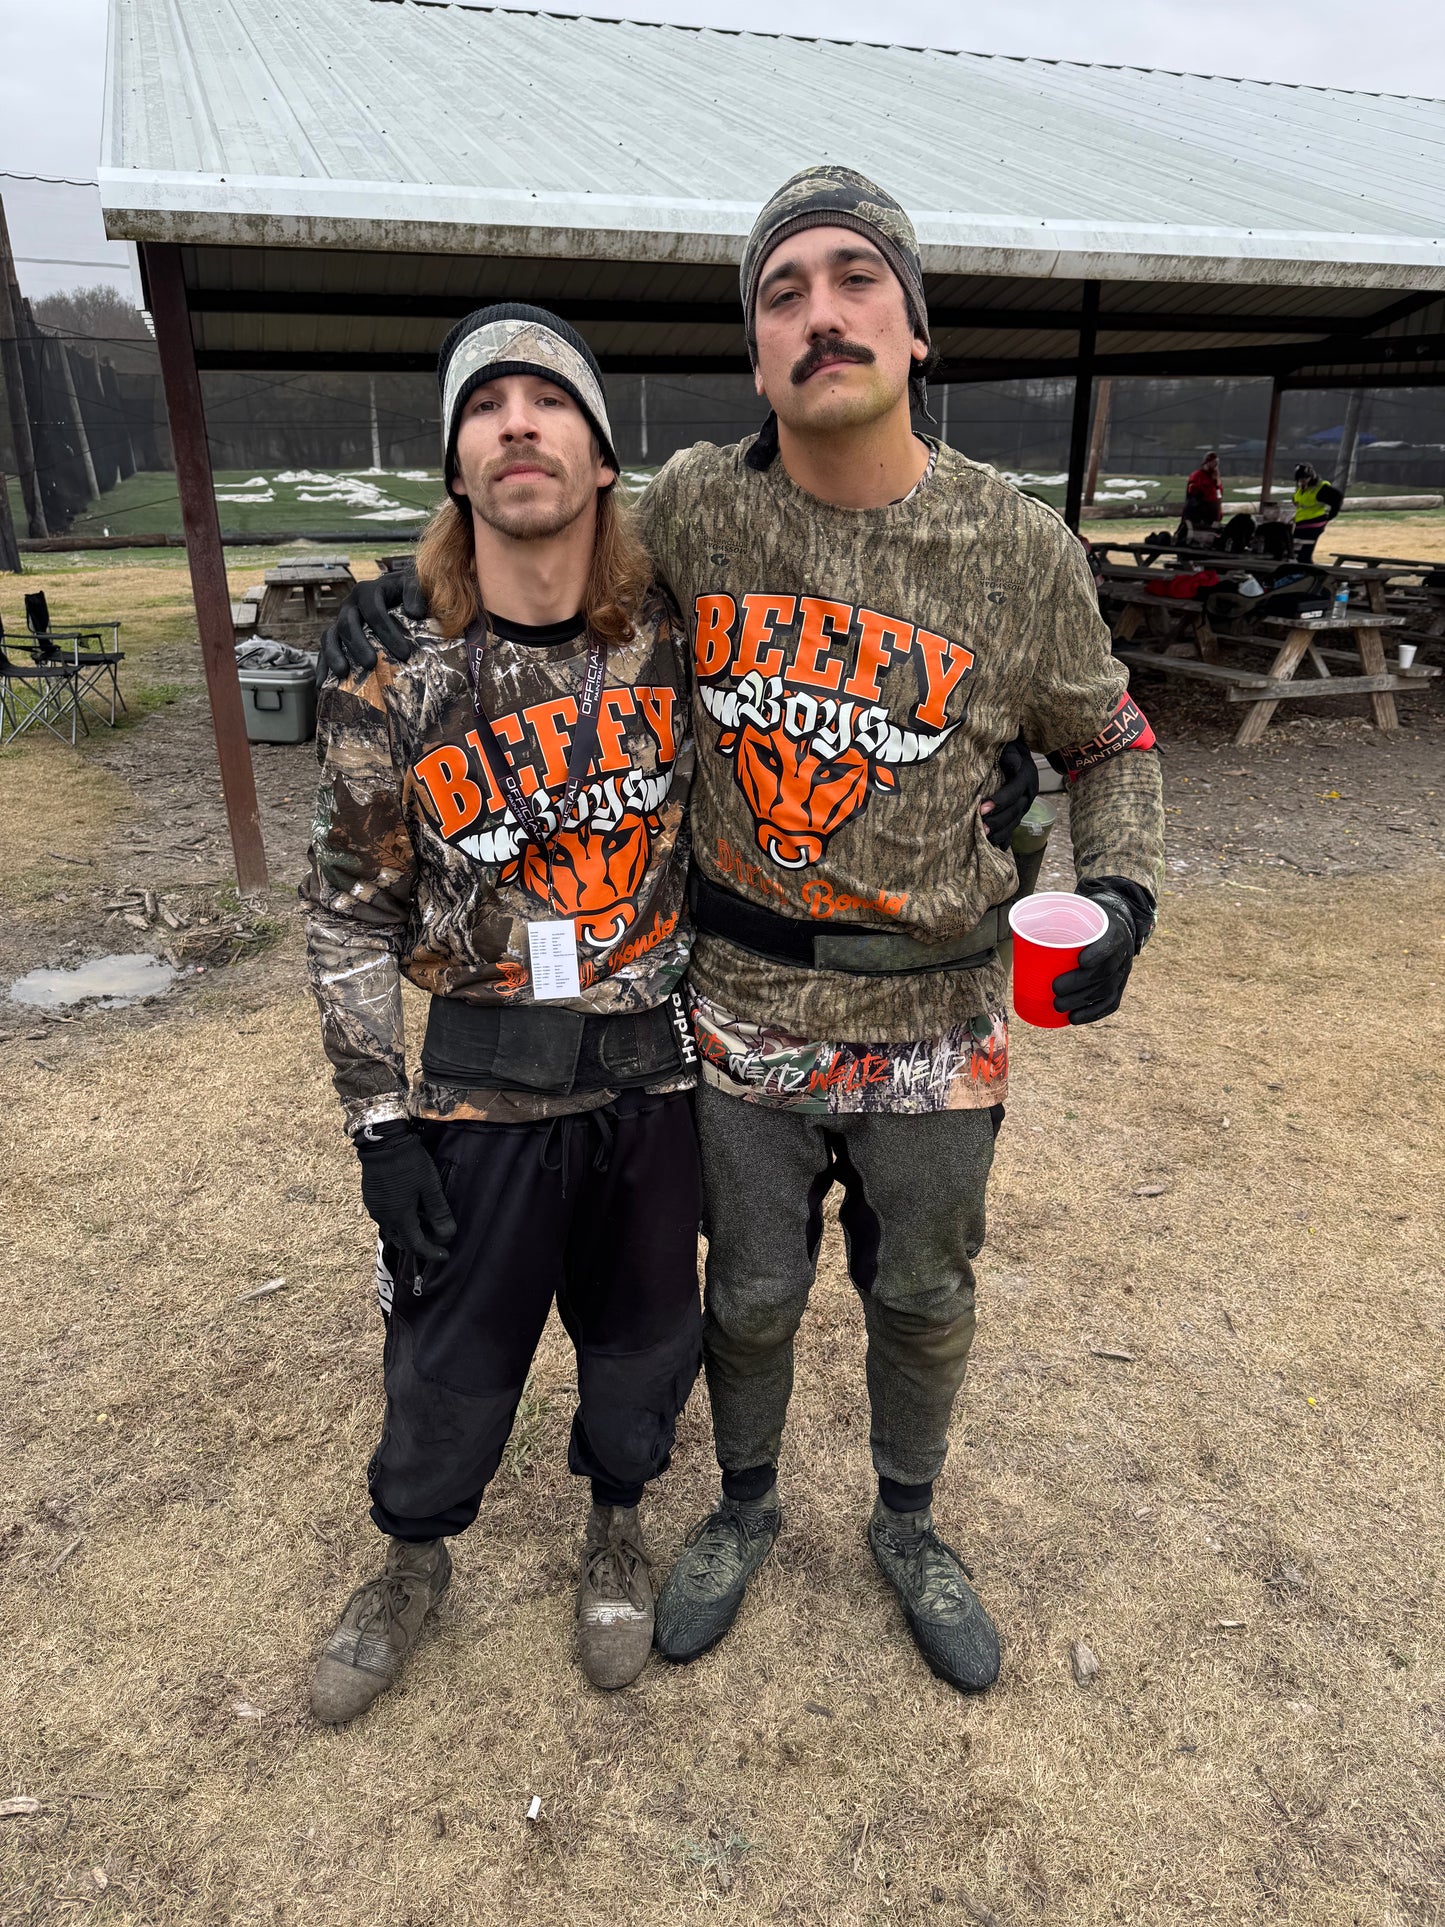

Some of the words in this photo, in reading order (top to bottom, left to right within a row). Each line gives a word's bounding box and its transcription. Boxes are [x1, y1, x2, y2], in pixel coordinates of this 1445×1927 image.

[581, 645, 600, 715] OFFICIAL
[594, 661, 604, 701] PAINTBALL
[695, 593, 975, 730] BEEFY
[736, 670, 889, 760] Boys
[1075, 729, 1139, 768] PAINTBALL
[413, 686, 678, 840] BEEFY
[505, 776, 543, 841] OFFICIAL
[507, 794, 529, 830] PAINTBALL
[671, 992, 698, 1064] Hydra
[808, 1050, 892, 1093] WELTZ
[893, 1040, 968, 1090] WELTZ
